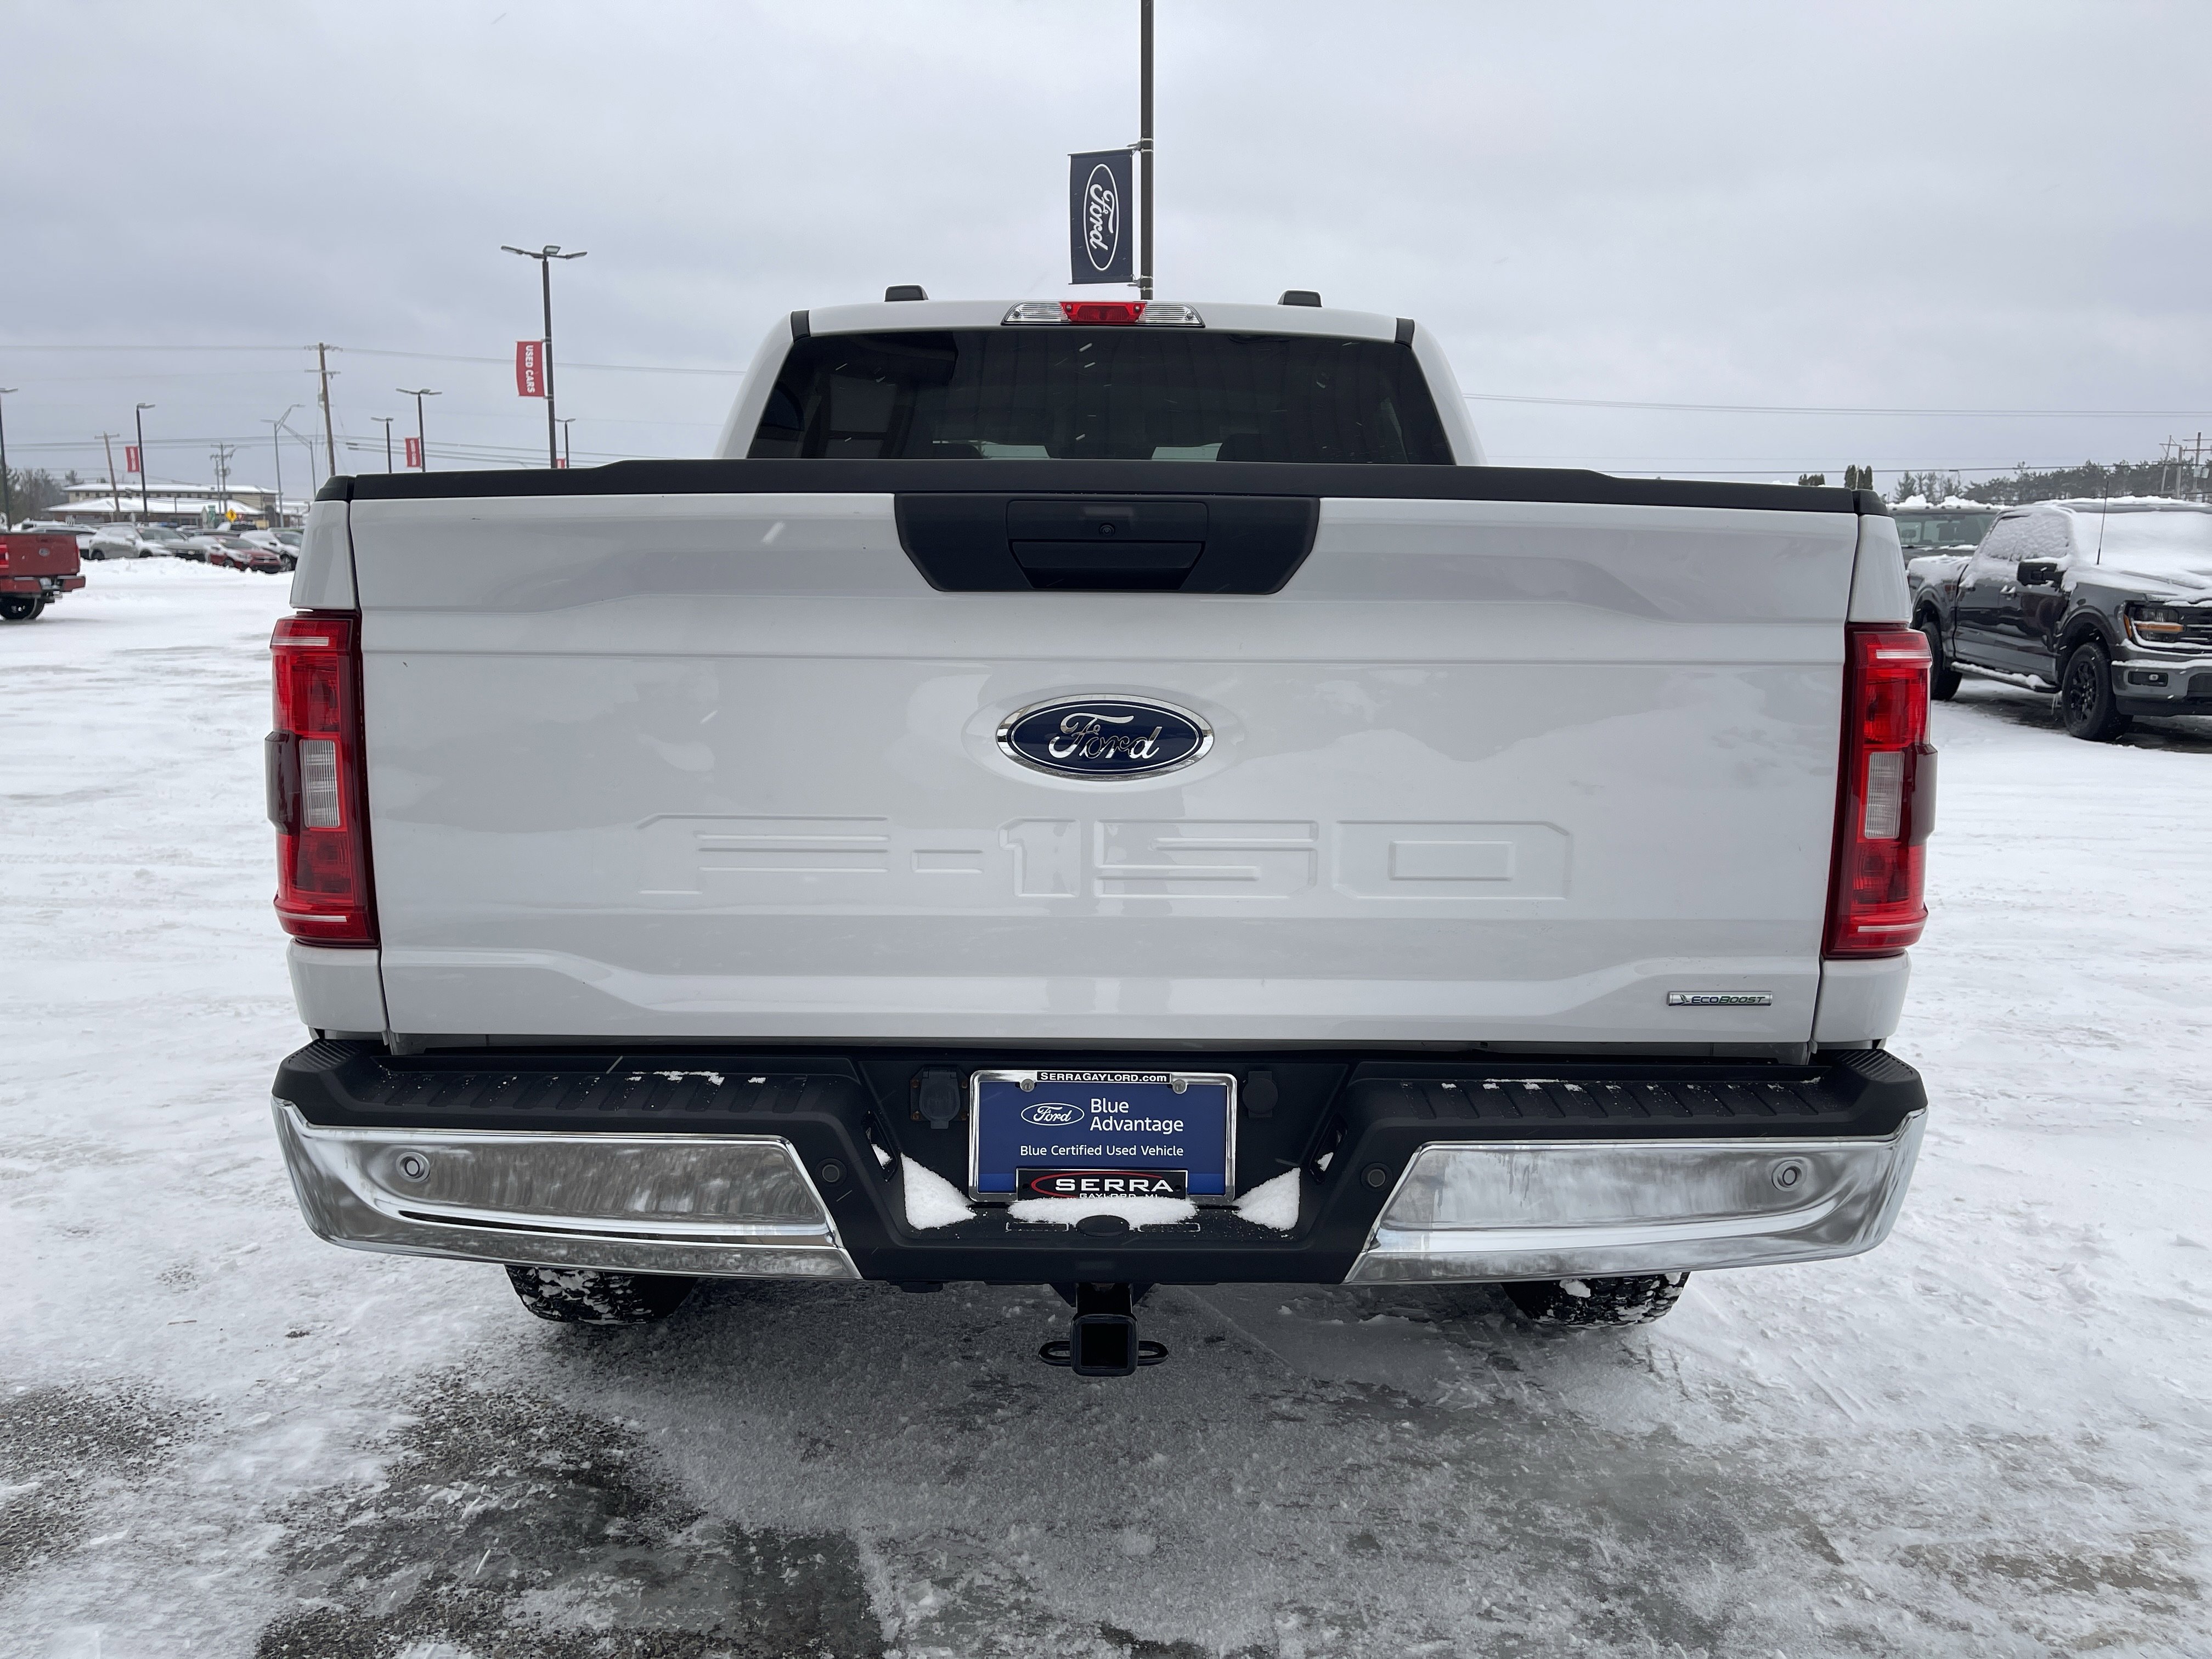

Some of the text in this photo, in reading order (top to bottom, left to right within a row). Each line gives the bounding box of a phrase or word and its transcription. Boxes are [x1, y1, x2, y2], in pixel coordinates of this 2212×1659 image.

[1090, 184, 1114, 250] Ford
[525, 345, 535, 393] USED CARS
[1048, 713, 1163, 759] Ford
[638, 814, 1570, 900] F-150
[1033, 1105, 1072, 1122] Ford
[1091, 1098, 1129, 1113] Blue
[1090, 1116, 1184, 1135] Advantage
[1020, 1144, 1184, 1156] Blue Certified Used Vehicle
[1055, 1178, 1173, 1192] SERRA
